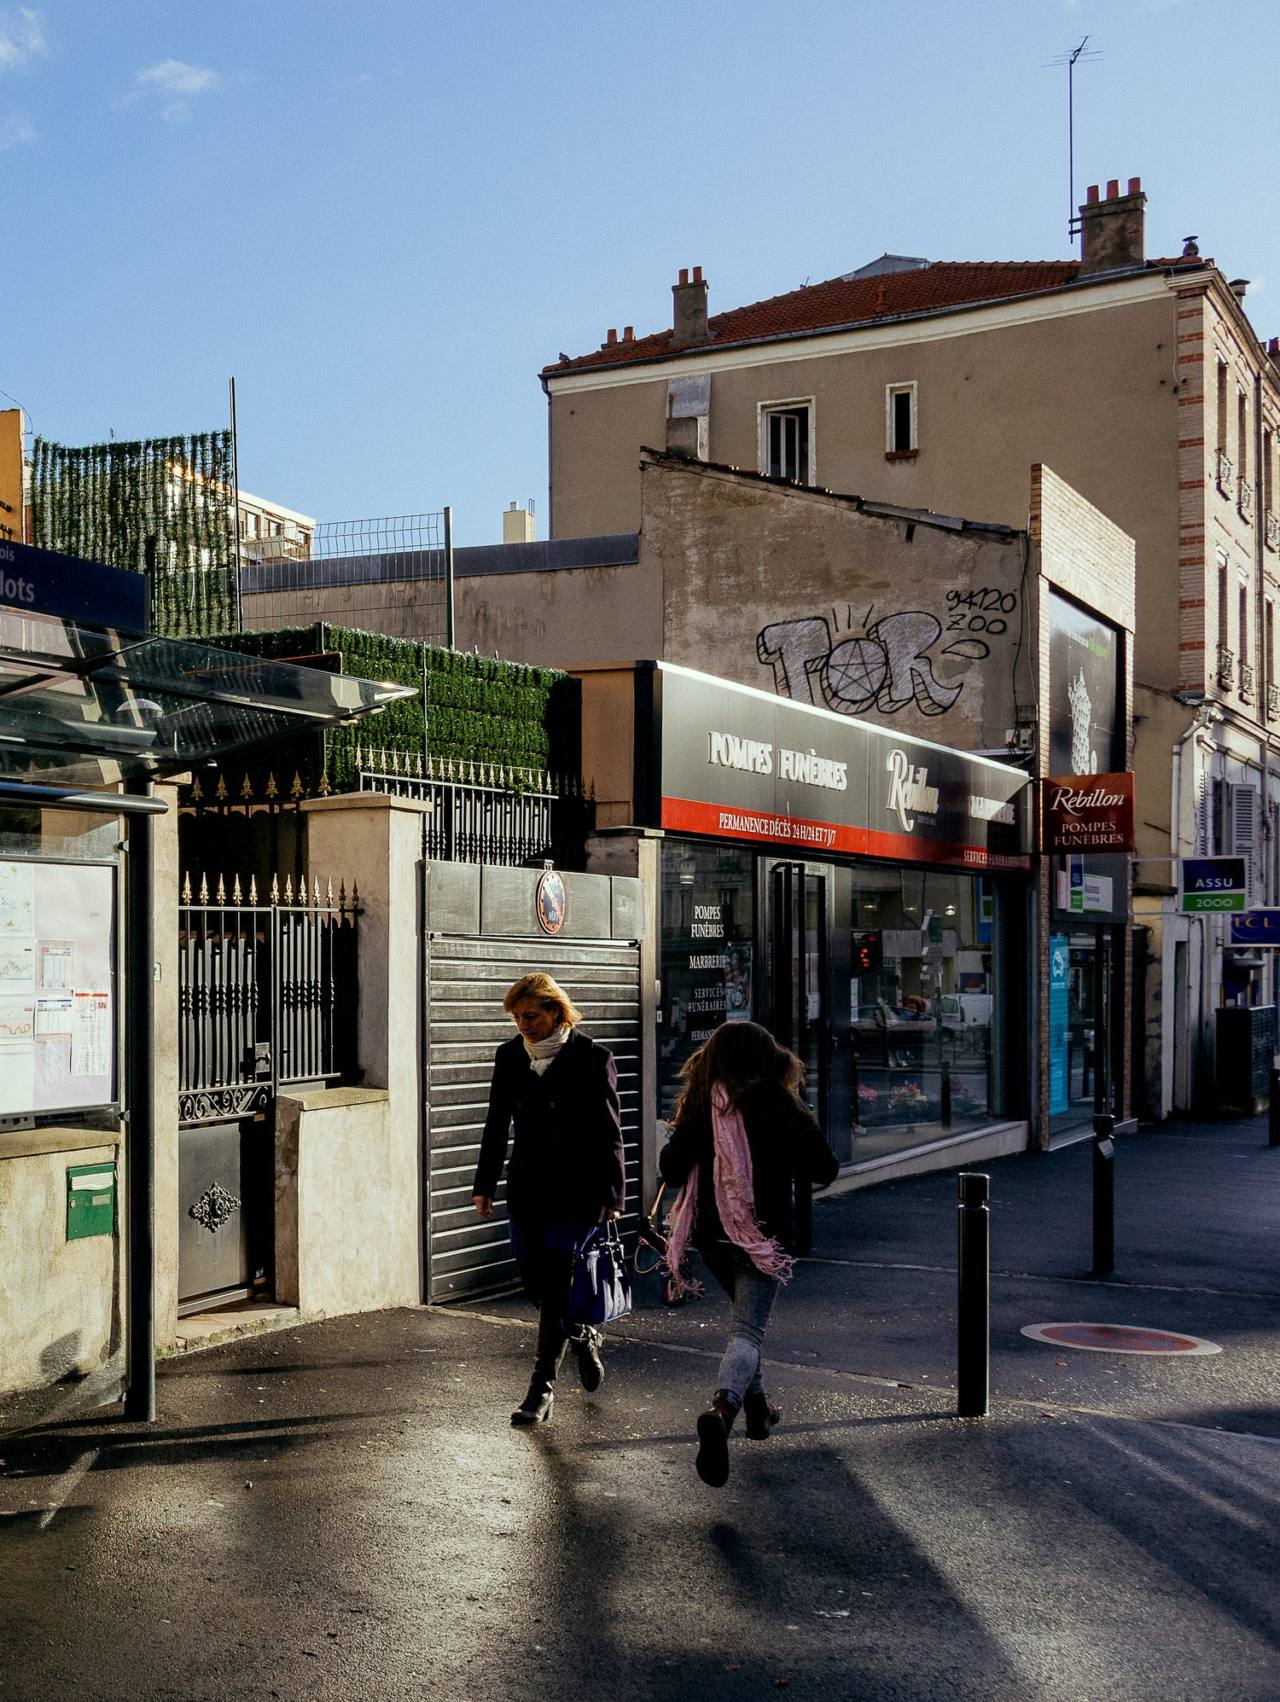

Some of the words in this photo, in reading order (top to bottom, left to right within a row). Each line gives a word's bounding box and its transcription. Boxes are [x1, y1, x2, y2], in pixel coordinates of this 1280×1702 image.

[707, 730, 773, 775] POMPES
[777, 747, 848, 792] FUNÈBRES
[1050, 786, 1125, 816] Rebillon
[718, 812, 769, 836] PERMANENCE
[769, 817, 792, 839] DÉCÈS
[1061, 821, 1117, 834] POMPES
[963, 849, 988, 865] SERVICES
[1195, 878, 1233, 888] ASSU
[1195, 898, 1233, 908] 2000
[694, 905, 721, 920] POMPES
[691, 921, 725, 938] FUNÈBRES
[694, 987, 724, 999] SERVICES
